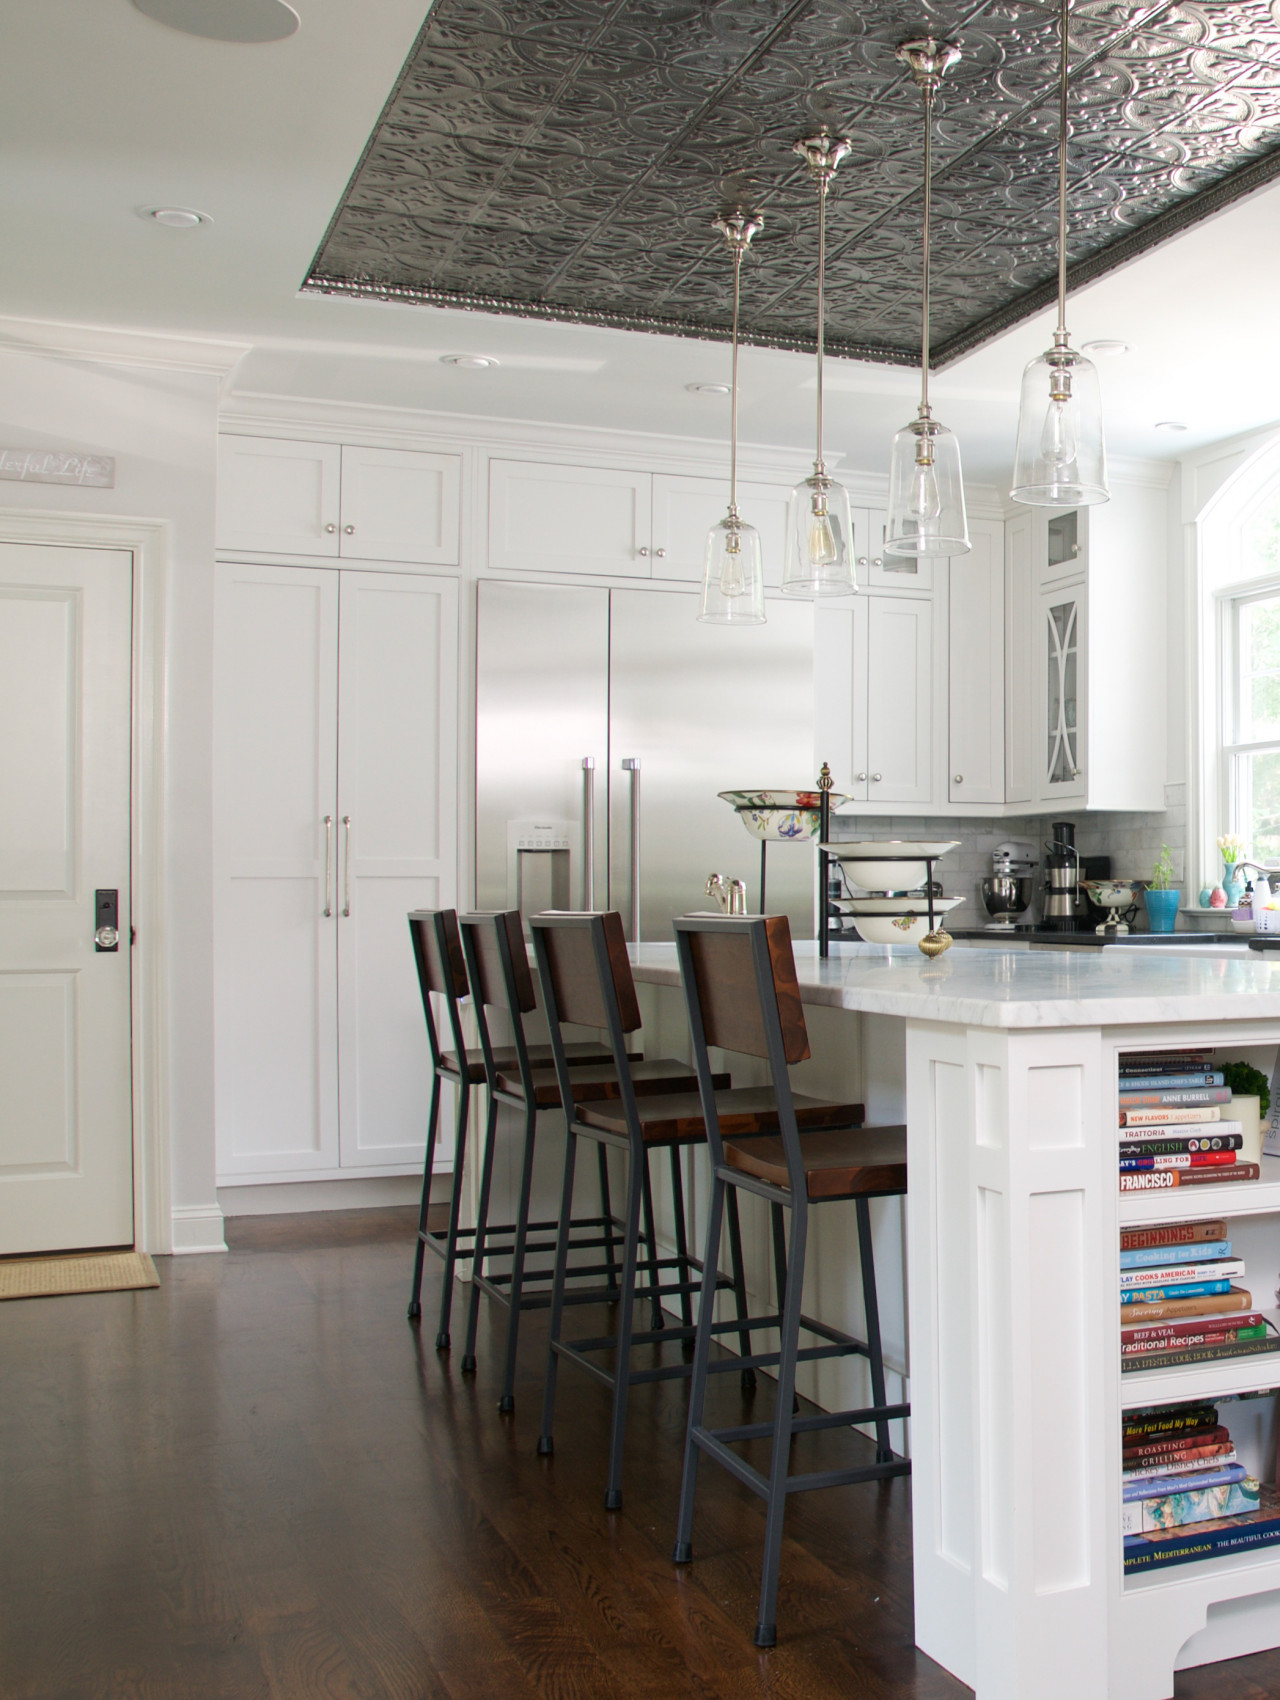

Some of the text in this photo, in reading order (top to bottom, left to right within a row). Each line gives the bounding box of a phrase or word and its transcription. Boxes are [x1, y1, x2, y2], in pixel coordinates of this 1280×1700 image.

[0, 451, 96, 484] erful Life
[1182, 1094, 1210, 1102] BURRELL
[1125, 1130, 1166, 1138] TRATTORIA
[1142, 1142, 1182, 1153] ENGLISH
[1137, 1158, 1173, 1166] GRILLING
[1120, 1172, 1174, 1190] FRANCISCO
[1122, 1226, 1194, 1249] BEGINNINGS
[1136, 1252, 1176, 1263] Cooking
[1178, 1250, 1190, 1258] for
[1190, 1248, 1212, 1257] Kids
[1135, 1273, 1158, 1282] COOKS
[1160, 1270, 1196, 1280] AMERICAN
[1132, 1290, 1165, 1301] PASTA
[1129, 1305, 1197, 1318] Savoring Appetizers
[1134, 1331, 1150, 1340] BEEF
[1150, 1330, 1156, 1338] &
[1158, 1328, 1175, 1336] VEAL
[1170, 1334, 1204, 1350] Recipes
[1122, 1361, 1140, 1370] LLA
[1171, 1354, 1192, 1364] COOK
[1193, 1350, 1214, 1360] BOOK
[1126, 1417, 1198, 1435] More Fast Food My Way
[1138, 1442, 1186, 1456] ROASTING
[1142, 1452, 1186, 1466] GRILLING
[1124, 1556, 1150, 1566] MPLETE
[1154, 1543, 1212, 1561] MEDITERRANEAN
[1230, 1535, 1262, 1546] BEAUTIFUL
